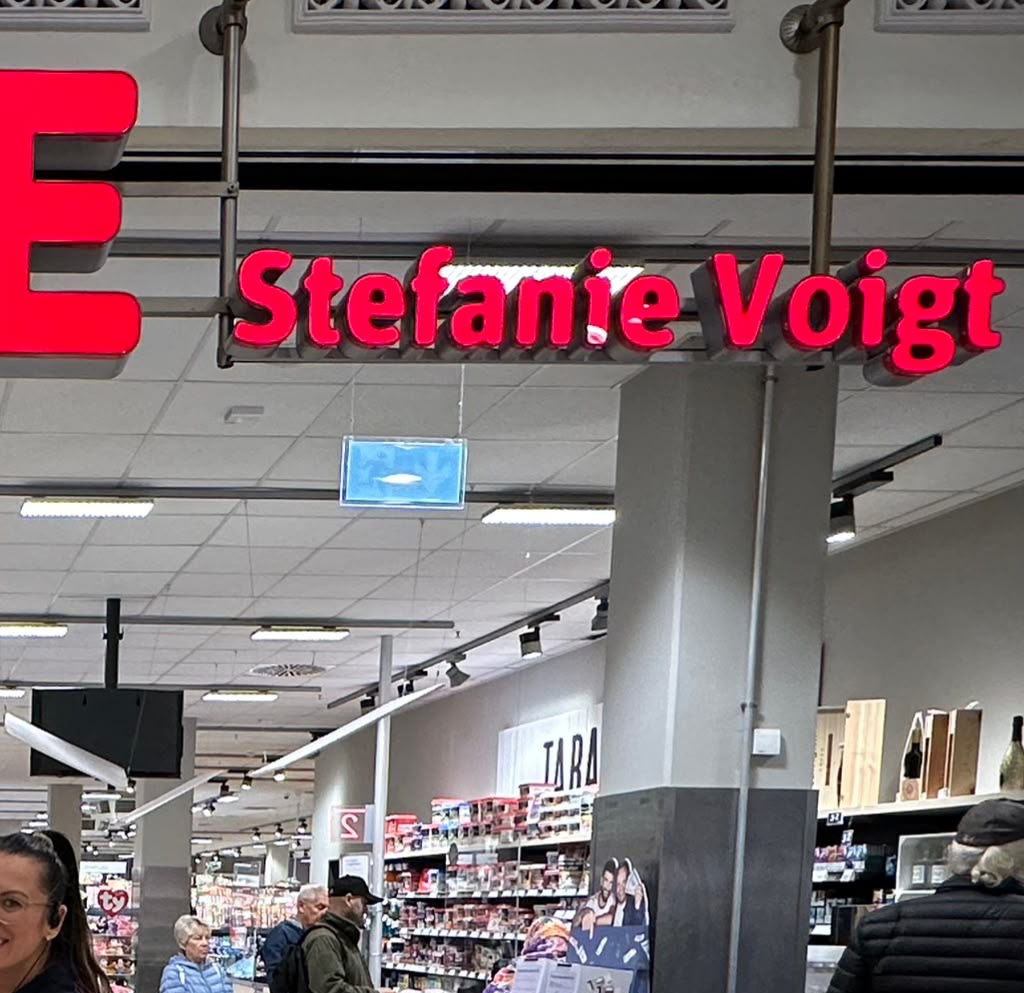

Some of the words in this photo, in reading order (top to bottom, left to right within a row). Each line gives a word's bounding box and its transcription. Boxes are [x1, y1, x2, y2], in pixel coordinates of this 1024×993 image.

[234, 246, 681, 349] Stefanie
[713, 248, 1005, 373] Voigt
[99, 890, 126, 913] ty
